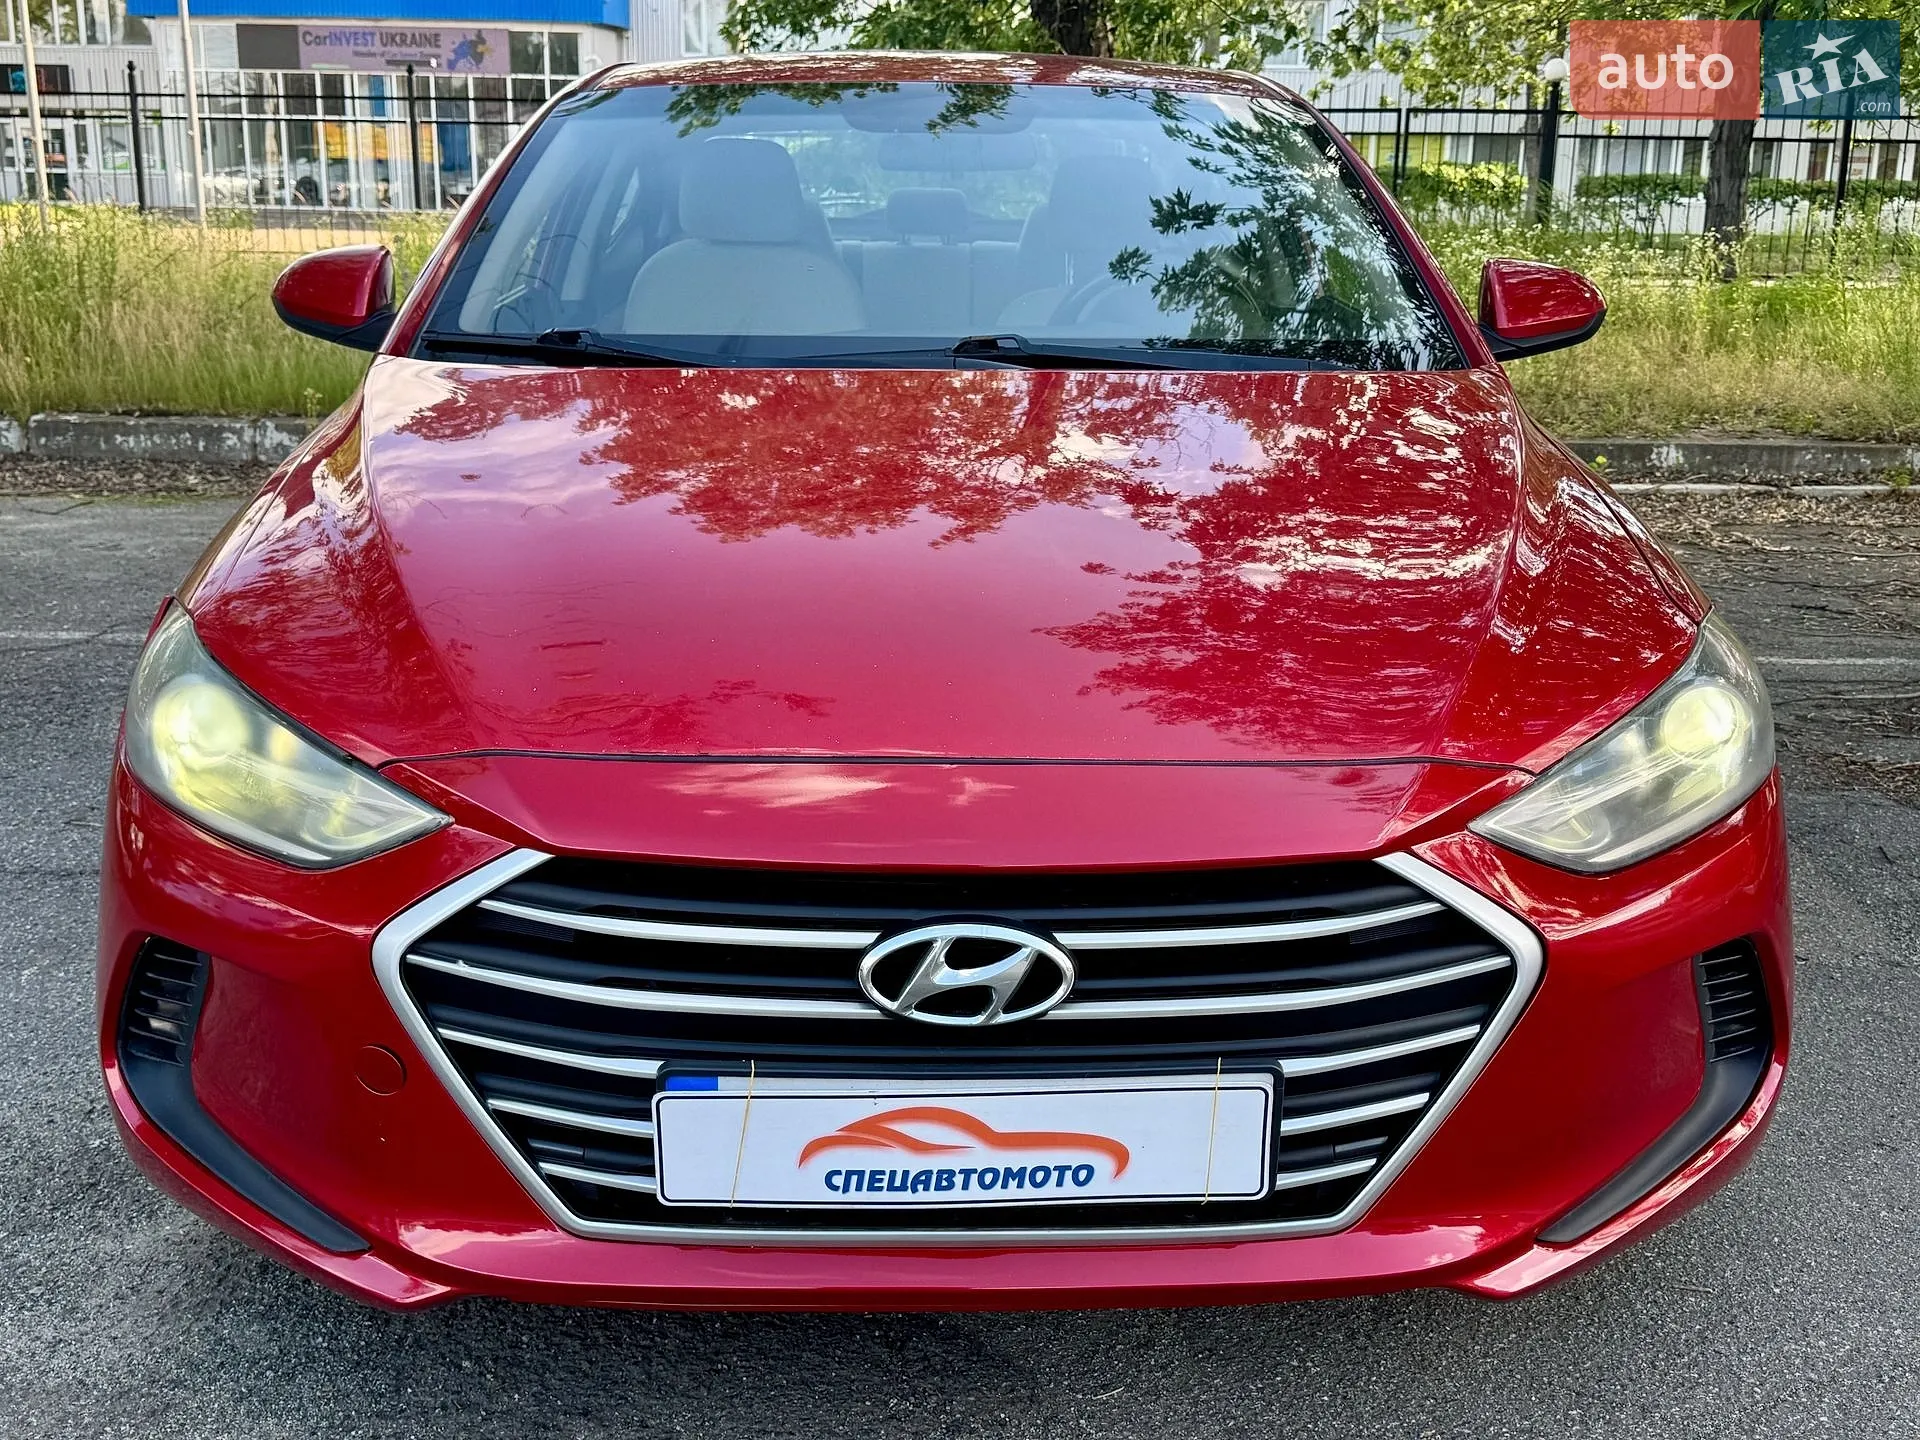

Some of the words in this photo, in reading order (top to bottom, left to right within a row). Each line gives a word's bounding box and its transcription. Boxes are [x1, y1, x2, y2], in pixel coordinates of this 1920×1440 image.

[302, 31, 376, 47] CarINVEST
[379, 32, 441, 48] UKRAINE
[824, 1164, 1095, 1194] СПЕЦАВТОМОТО
